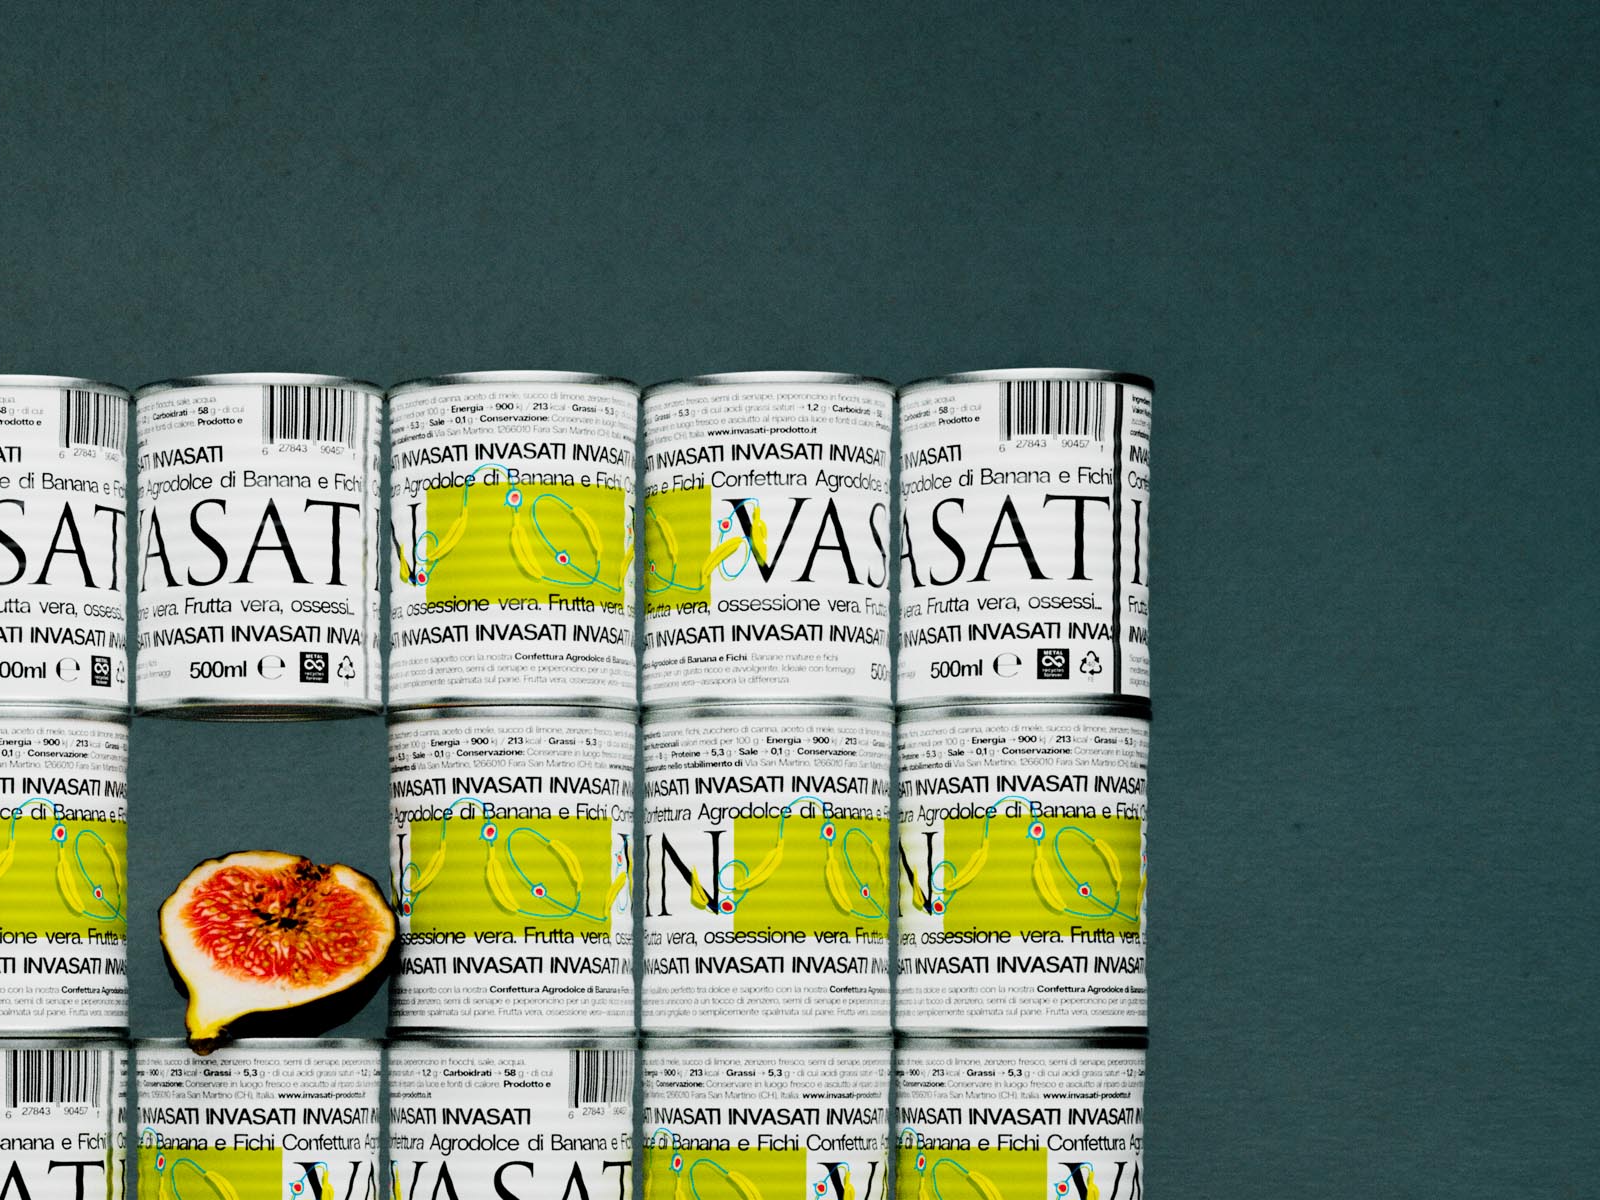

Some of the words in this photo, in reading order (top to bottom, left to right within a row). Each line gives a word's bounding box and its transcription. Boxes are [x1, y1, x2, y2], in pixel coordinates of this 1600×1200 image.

[153, 446, 222, 468] INVASATI
[475, 443, 565, 460] INVASATI
[732, 443, 822, 461] INVASATI
[981, 468, 1050, 485] Banana
[407, 595, 489, 616] ossessione
[718, 599, 820, 612] ossessione
[190, 661, 246, 678] 500ml
[931, 659, 982, 678] 500ml
[453, 777, 542, 794] INVASATI
[695, 776, 783, 794] INVASATI
[996, 775, 1088, 793] INVASATI
[698, 802, 791, 825] Agrodolce
[1030, 801, 1096, 818] Banana
[45, 932, 83, 944] vera.
[704, 926, 806, 944] ossessione
[1071, 926, 1114, 943] Frutta
[206, 1108, 295, 1125] INVASATI
[443, 1108, 530, 1125] INVASATI
[729, 1109, 819, 1125] INVASATI
[969, 1108, 1061, 1125] INVASATI
[758, 1134, 799, 1151] Fichi
[1048, 1134, 1125, 1151] Confettura
